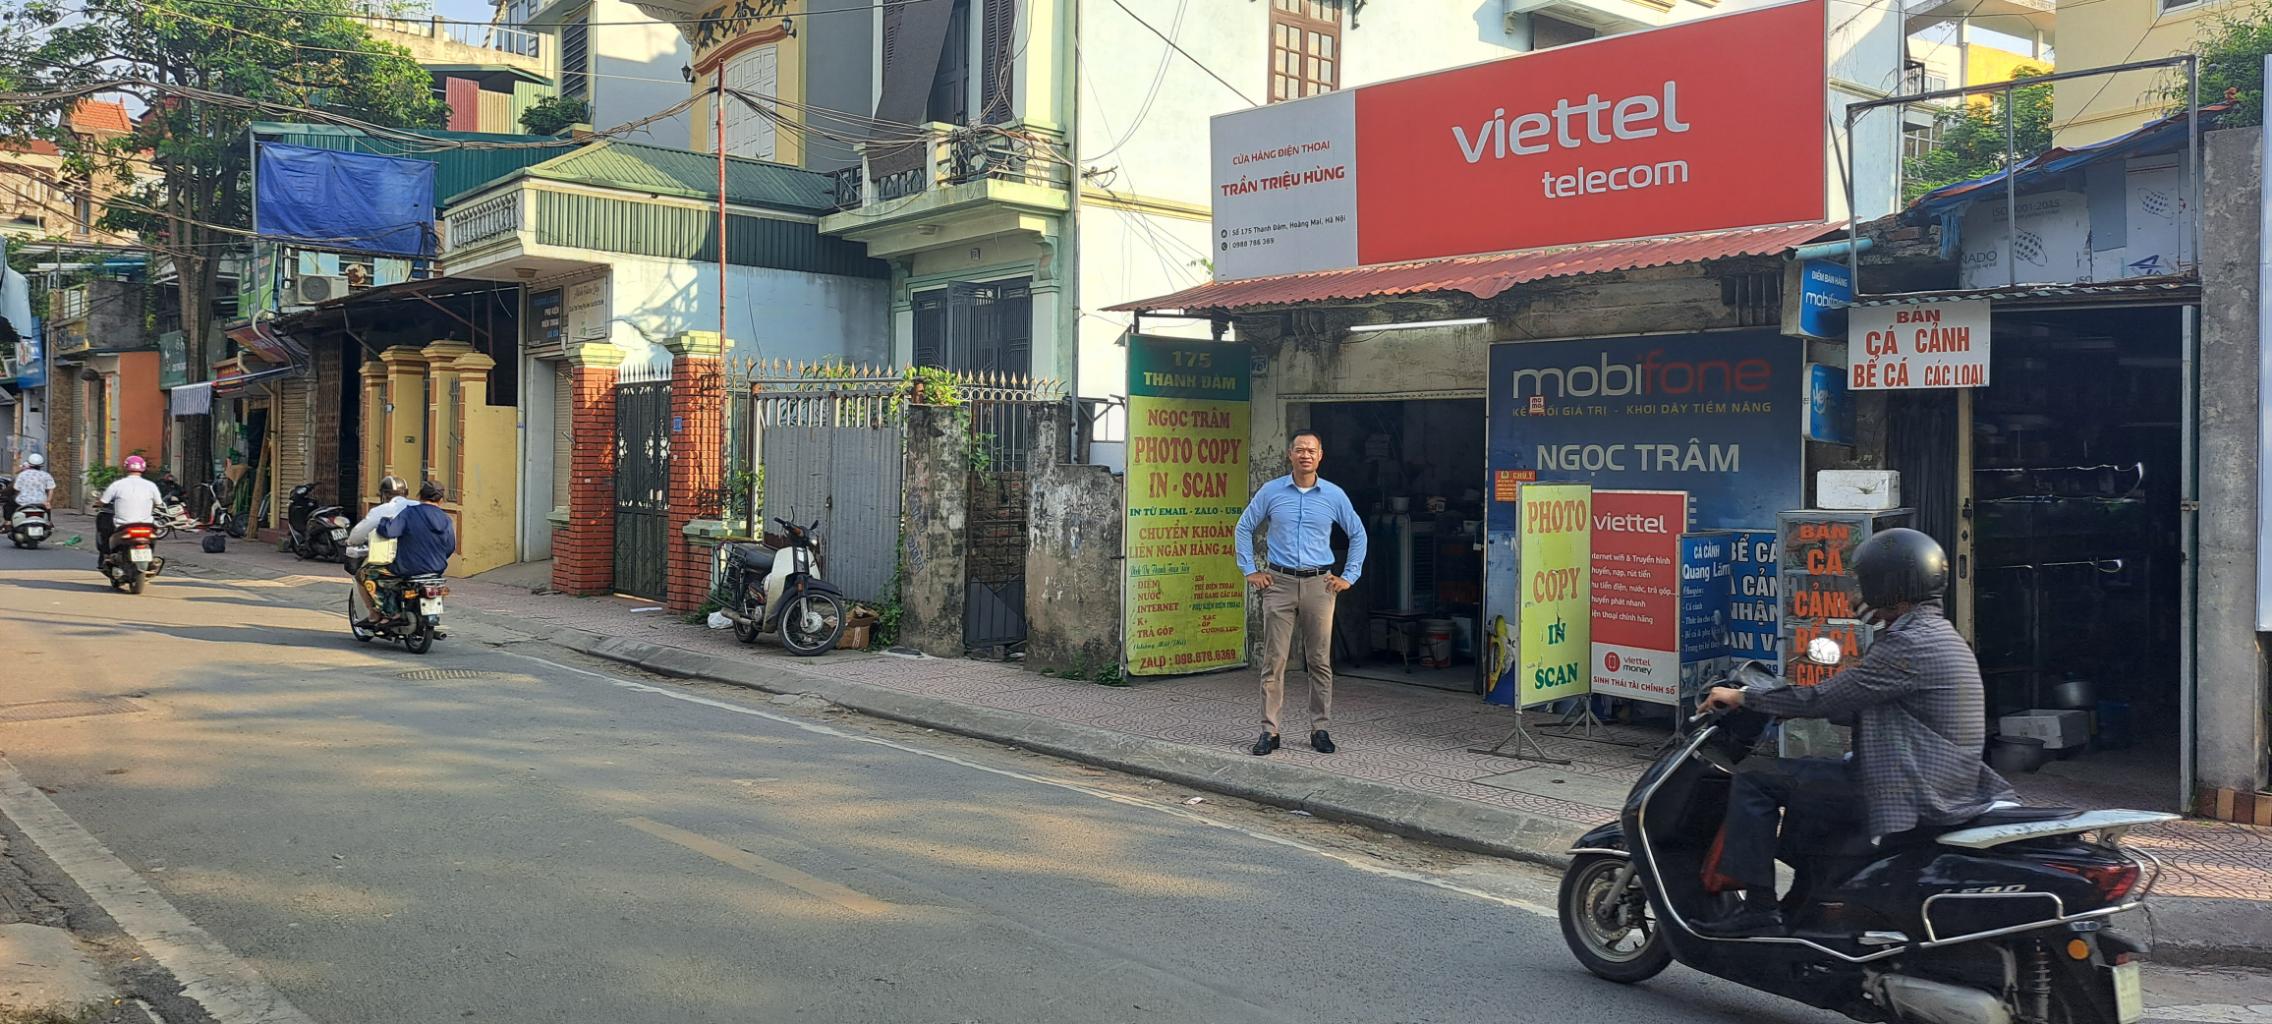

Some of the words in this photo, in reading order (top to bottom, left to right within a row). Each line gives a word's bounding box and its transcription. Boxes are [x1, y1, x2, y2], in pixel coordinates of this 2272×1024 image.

[1451, 80, 1691, 164] viettel
[1232, 151, 1250, 165] CỬA
[1251, 149, 1276, 163] HÀNG
[1278, 145, 1300, 158] ĐIỆN
[1301, 140, 1330, 154] THOẠI
[1221, 174, 1258, 197] TRẦN
[1260, 171, 1301, 191] TRIỆU
[1303, 165, 1345, 184] HÙNG
[1541, 159, 1689, 199] telecom
[1241, 227, 1252, 235] 175
[1254, 225, 1272, 234] Thanh
[1896, 305, 1941, 324] BÁN
[1866, 325, 1898, 356] CÁ
[1915, 322, 1970, 354] CẢNH
[1172, 351, 1213, 368] 175
[1144, 371, 1197, 389] THANH
[1512, 350, 1772, 399] mobifone
[1853, 354, 1880, 388] BỂ
[1884, 357, 1909, 388] CÁ
[1924, 359, 1951, 386] CÁC
[1148, 408, 1188, 431] NGỌC
[1191, 407, 1231, 429] TRÂM
[1134, 436, 1193, 465] PHOTO
[1197, 438, 1242, 465] COPY
[1537, 444, 1625, 477] NGỌC
[1634, 437, 1740, 473] TRÂM
[1148, 472, 1169, 498] IN
[1182, 472, 1229, 498] SCAN
[1129, 508, 1141, 517] IN
[1159, 507, 1188, 516] EMAIL
[1195, 506, 1219, 515] ZALO
[1225, 506, 1242, 515] USB
[1527, 499, 1587, 534] PHOTO
[1139, 519, 1190, 540] CHUYỂN
[1593, 512, 1668, 534] viettel
[1156, 541, 1187, 557] NGÂN
[1190, 540, 1220, 556] HÀNG
[1592, 566, 1612, 576] huyển,
[1683, 563, 1710, 582] Quang
[1533, 567, 1581, 604] COPY
[1137, 602, 1179, 613] INTERNET
[1592, 595, 1609, 605] huyển
[1592, 609, 1601, 617] iện
[1548, 622, 1567, 645] IN
[1140, 655, 1166, 670] ZALO
[1623, 656, 1651, 667] viettel
[1623, 664, 1653, 676] money
[1534, 662, 1578, 690] SCAN
[1593, 675, 1610, 684] SINH
[1641, 682, 1664, 693] CHÍNH
[1665, 684, 1676, 695] SỐ
